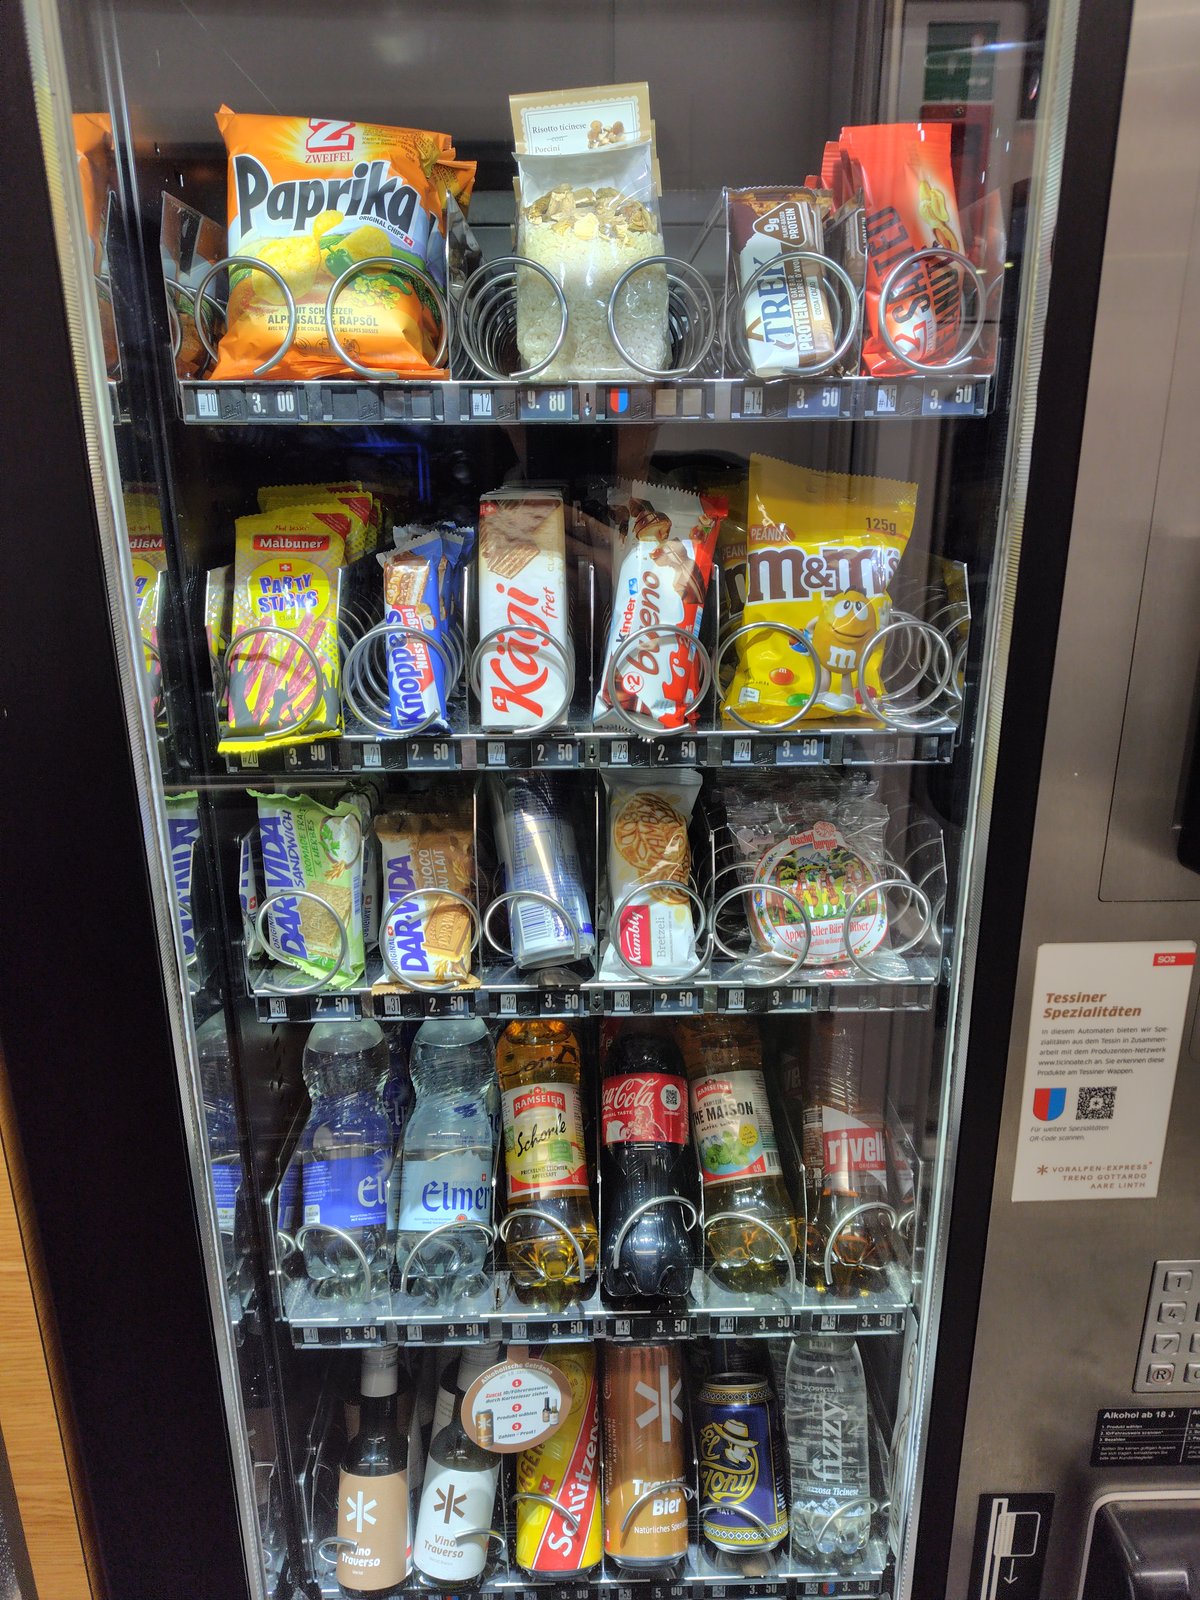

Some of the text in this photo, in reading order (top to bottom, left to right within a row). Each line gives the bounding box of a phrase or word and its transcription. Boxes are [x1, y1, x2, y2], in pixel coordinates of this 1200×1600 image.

[532, 122, 587, 134] Risotto ticinese
[305, 152, 353, 163] ZWEIFEL
[233, 157, 419, 238] Paprika
[359, 215, 404, 239] ORIGINAL CHIPS
[764, 217, 779, 232] 9g
[785, 208, 800, 240] PROTEIN
[753, 252, 794, 343] TREK
[339, 314, 379, 326] RAPSÖL
[792, 299, 814, 351] PROTEIN
[200, 392, 218, 413] #10
[252, 392, 266, 413] 3.
[276, 391, 295, 412] 00
[473, 392, 491, 413] #12
[528, 390, 540, 409] 9.
[549, 391, 566, 412] 80
[746, 387, 838, 410] #14 3. 50
[930, 384, 972, 409] 3. 50
[751, 527, 790, 541] PEANUT
[865, 517, 897, 535] 125g
[260, 539, 322, 549] Malbuner
[259, 573, 312, 594] PARTY
[258, 590, 319, 613] STICKS
[541, 586, 558, 619] fret
[625, 570, 661, 676] bueno
[413, 642, 429, 670] Nuss
[490, 582, 550, 718] Kägi
[829, 646, 856, 669] m
[289, 747, 301, 765] 3.
[366, 743, 449, 764] #21 2. 50
[490, 743, 573, 762] #22 2. 50
[613, 741, 696, 761] #23 2. 50
[735, 739, 818, 758] #24 3. 50
[282, 809, 305, 889] SANDWICH
[435, 848, 449, 875] LAIT
[625, 911, 643, 965] Kambly
[656, 916, 666, 959] Bretzeli
[385, 996, 464, 1012] #31 2. 50
[545, 994, 555, 1008] 3.
[565, 994, 579, 1009] 50
[661, 993, 671, 1008] 2.
[680, 991, 693, 1007] 50
[772, 990, 783, 1005] 3.
[1046, 992, 1107, 1003] Tessiner
[271, 998, 349, 1014] #30 2. 50
[1043, 1006, 1142, 1020] Spezialitäten
[1154, 1026, 1169, 1034] Spe-
[515, 1095, 563, 1111] RAMSEIER
[705, 1101, 754, 1121] MAISON
[517, 1113, 567, 1158] Schorle
[1052, 1164, 1148, 1172] VORALPEN-EXPRESS
[1176, 1277, 1182, 1288] 1
[861, 1314, 892, 1327] 3. 50
[1168, 1308, 1177, 1318] 4
[552, 1321, 583, 1335] 3. 50
[656, 1320, 687, 1333] 3. 50
[759, 1316, 790, 1329] 3. 50
[345, 1326, 377, 1340] 3. 50
[448, 1324, 479, 1338] 3. 50
[1162, 1339, 1173, 1350] 7
[1156, 1370, 1166, 1380] R
[1103, 1411, 1140, 1419] Alkohol
[812, 1399, 849, 1483] fizzy
[652, 1497, 682, 1516] Bier
[634, 1525, 671, 1534] Natürliches
[424, 1540, 464, 1558] Traverso
[434, 1534, 456, 1548] Vino
[342, 1553, 381, 1567] Traverso
[655, 1588, 664, 1598] 5.
[749, 1584, 777, 1595] 3. 50
[842, 1581, 870, 1592] 3. 50
